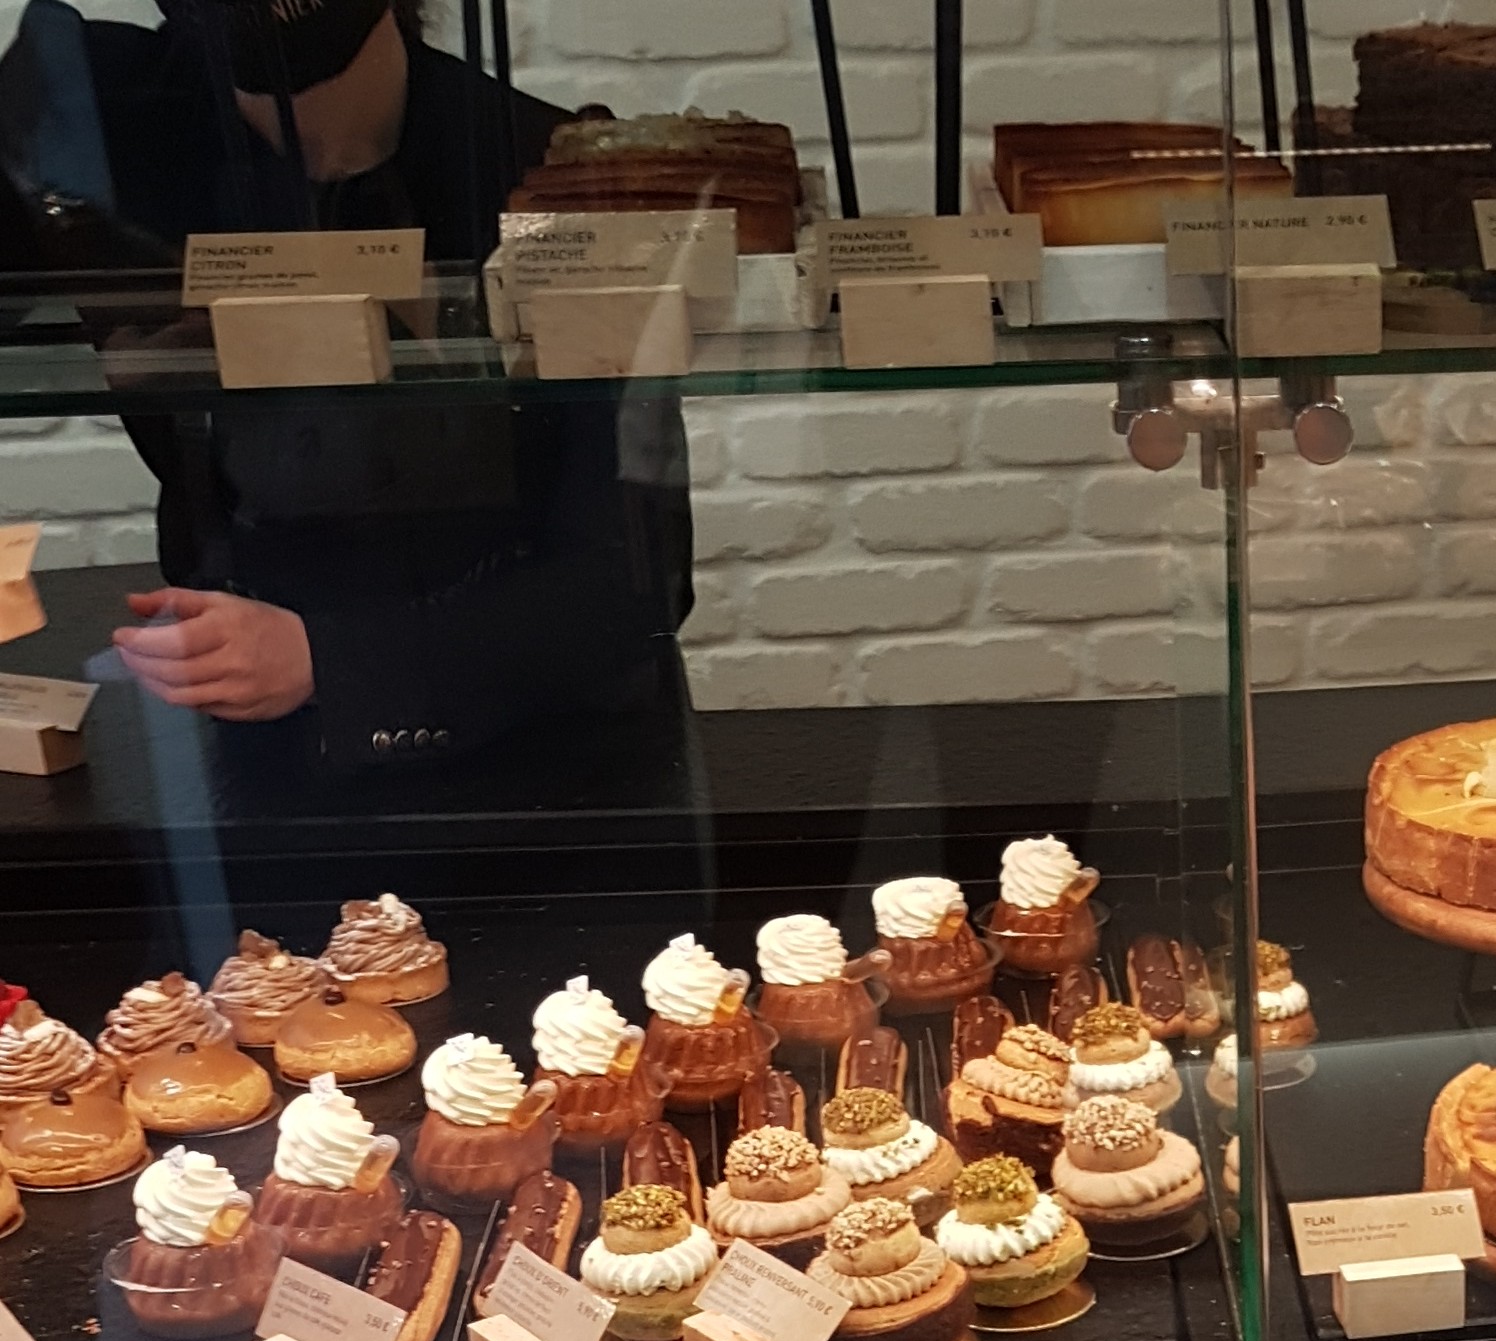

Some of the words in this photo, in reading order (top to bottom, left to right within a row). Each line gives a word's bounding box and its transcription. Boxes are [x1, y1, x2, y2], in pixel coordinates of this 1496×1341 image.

[1171, 218, 1249, 231] FINANCR
[1252, 216, 1310, 230] NATURE
[1357, 214, 1368, 226] €
[828, 229, 908, 242] FINANCIER
[1002, 227, 1013, 238] €
[191, 245, 275, 257] FINANCIER
[389, 243, 401, 254] €
[514, 248, 587, 262] PISTACHE
[829, 242, 914, 255] FRAMBOISE
[190, 260, 247, 271] CITRON
[1303, 1214, 1336, 1228] FLAN
[1457, 1203, 1466, 1215] €
[729, 1249, 757, 1273] CHOUX
[756, 1262, 809, 1299] RENVERSANT
